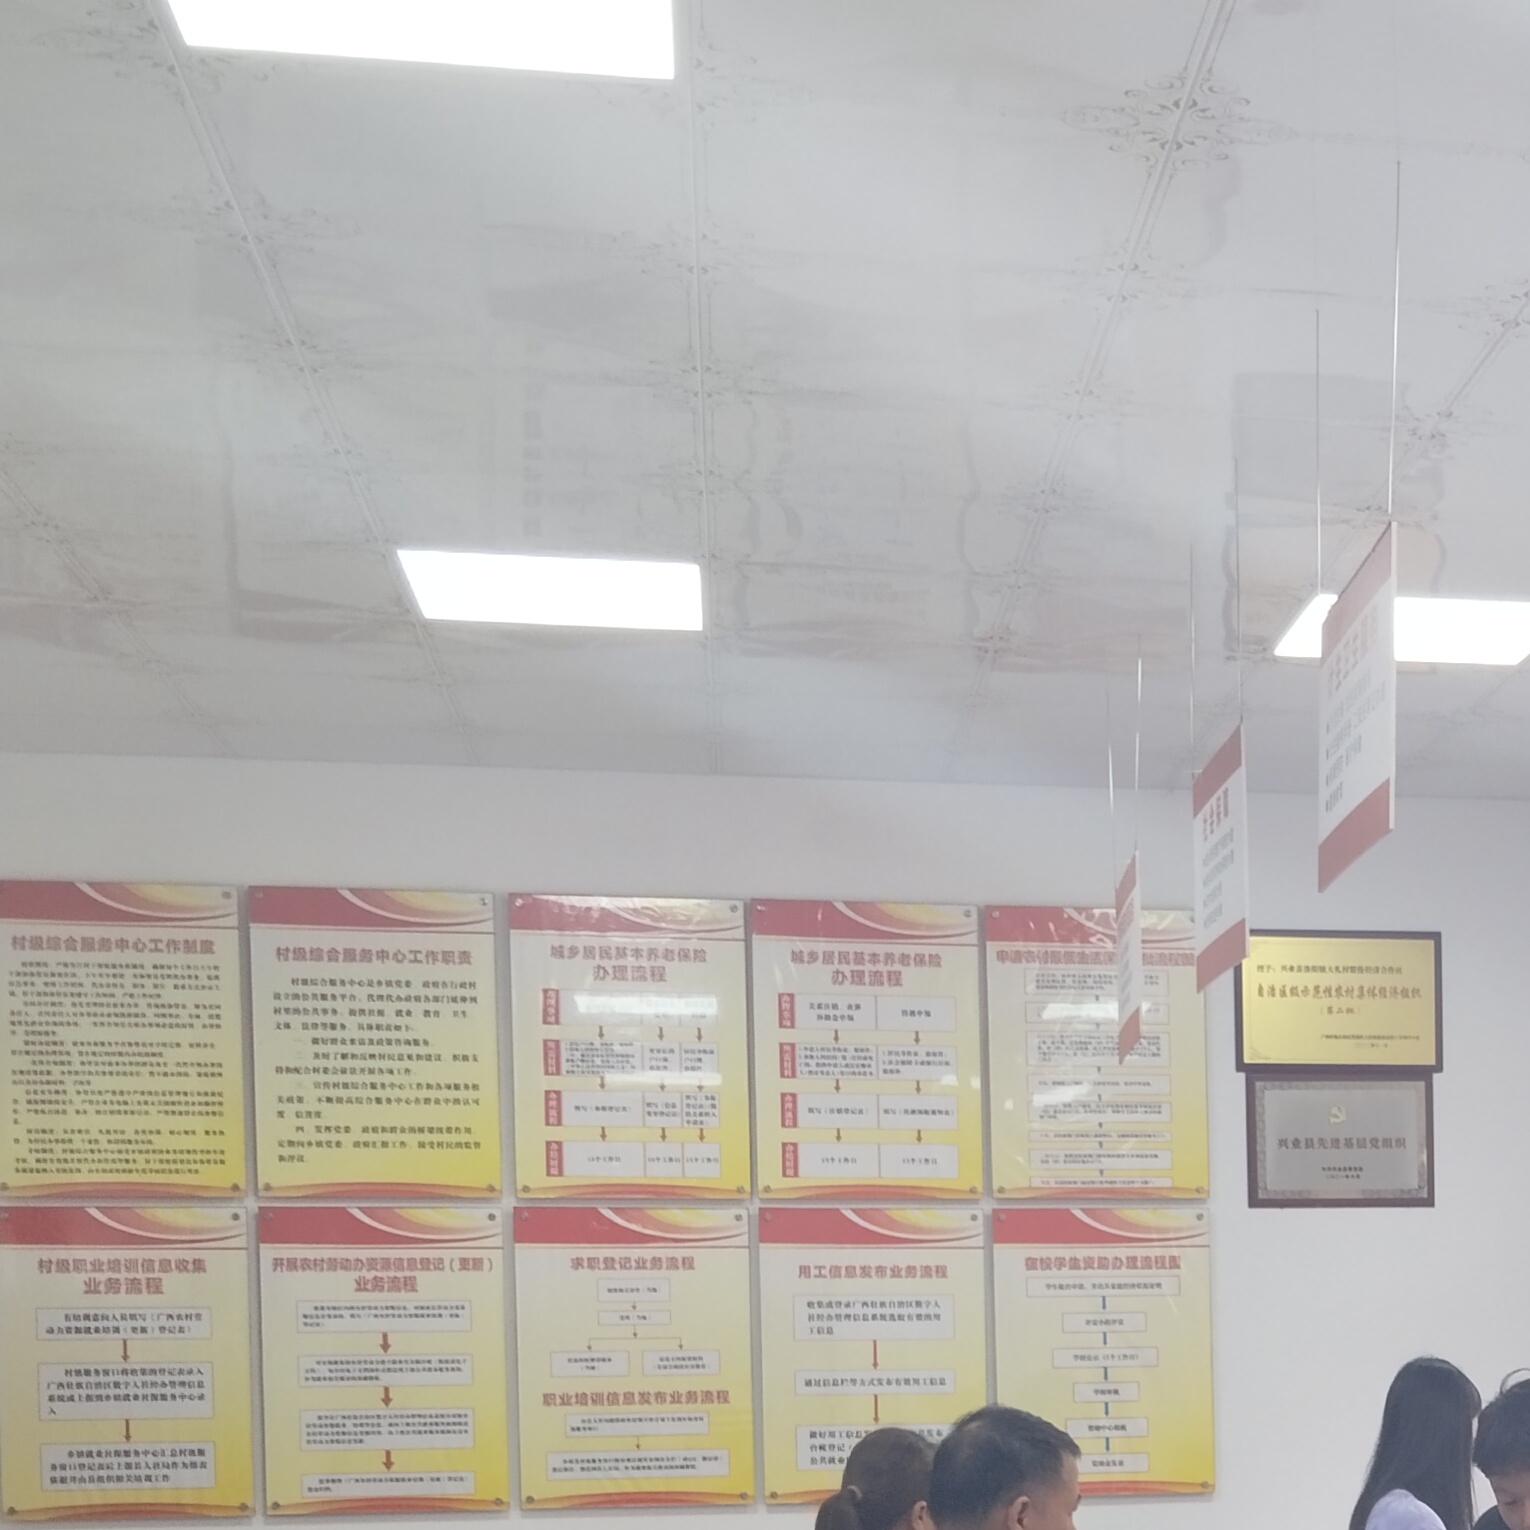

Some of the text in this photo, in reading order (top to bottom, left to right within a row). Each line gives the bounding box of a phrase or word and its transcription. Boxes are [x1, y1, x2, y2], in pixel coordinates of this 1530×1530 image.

[11, 935, 215, 955] 村级综合服务中心工作制度
[551, 945, 706, 963] 城乡居民基本养老保险
[276, 946, 472, 966] 村级综合服务中心工作职责
[791, 949, 942, 968] 城乡居民基本养老保险
[593, 964, 667, 982] 办理流程
[832, 968, 903, 986] 办理流程
[1277, 1137, 1407, 1150] 兴业县先进基层党组织
[38, 1257, 207, 1275] 村级职业培训信息收集
[570, 1256, 696, 1272] 求职登记业务流程
[1024, 1256, 1181, 1270] 在校学生资助办理流程图
[798, 1265, 948, 1280] 用工信息发布业务流程
[84, 1277, 164, 1295] 业务流程
[354, 1276, 418, 1293] 业务流程
[543, 1390, 730, 1406] 职业培训信息发布业务流程
